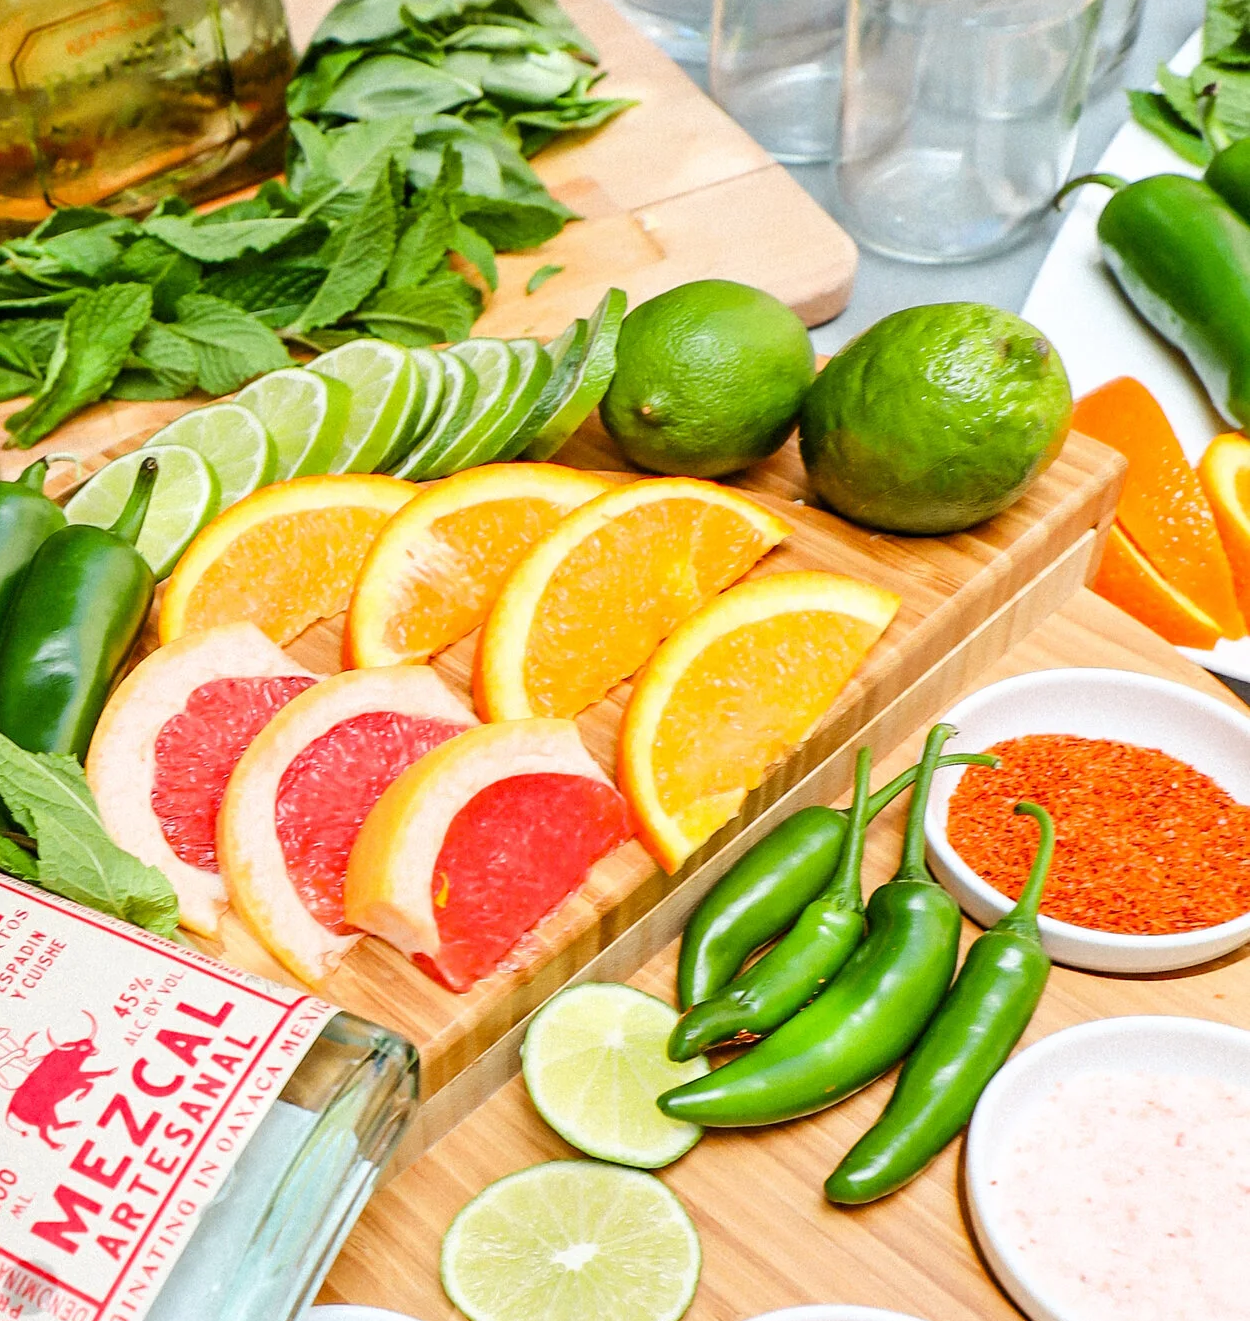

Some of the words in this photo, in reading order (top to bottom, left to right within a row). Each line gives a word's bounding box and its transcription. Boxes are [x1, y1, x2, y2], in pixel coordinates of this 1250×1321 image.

[11, 987, 27, 1001] Y
[22, 938, 67, 988] CUISHE
[113, 977, 153, 1018] 45%
[143, 997, 163, 1016] BY
[30, 1000, 236, 1256] MEZCAL
[96, 1033, 259, 1261] ARTESANAL
[193, 1160, 220, 1190] IN
[216, 1064, 282, 1153] OAXACA
[278, 1000, 330, 1057] MEXIC
